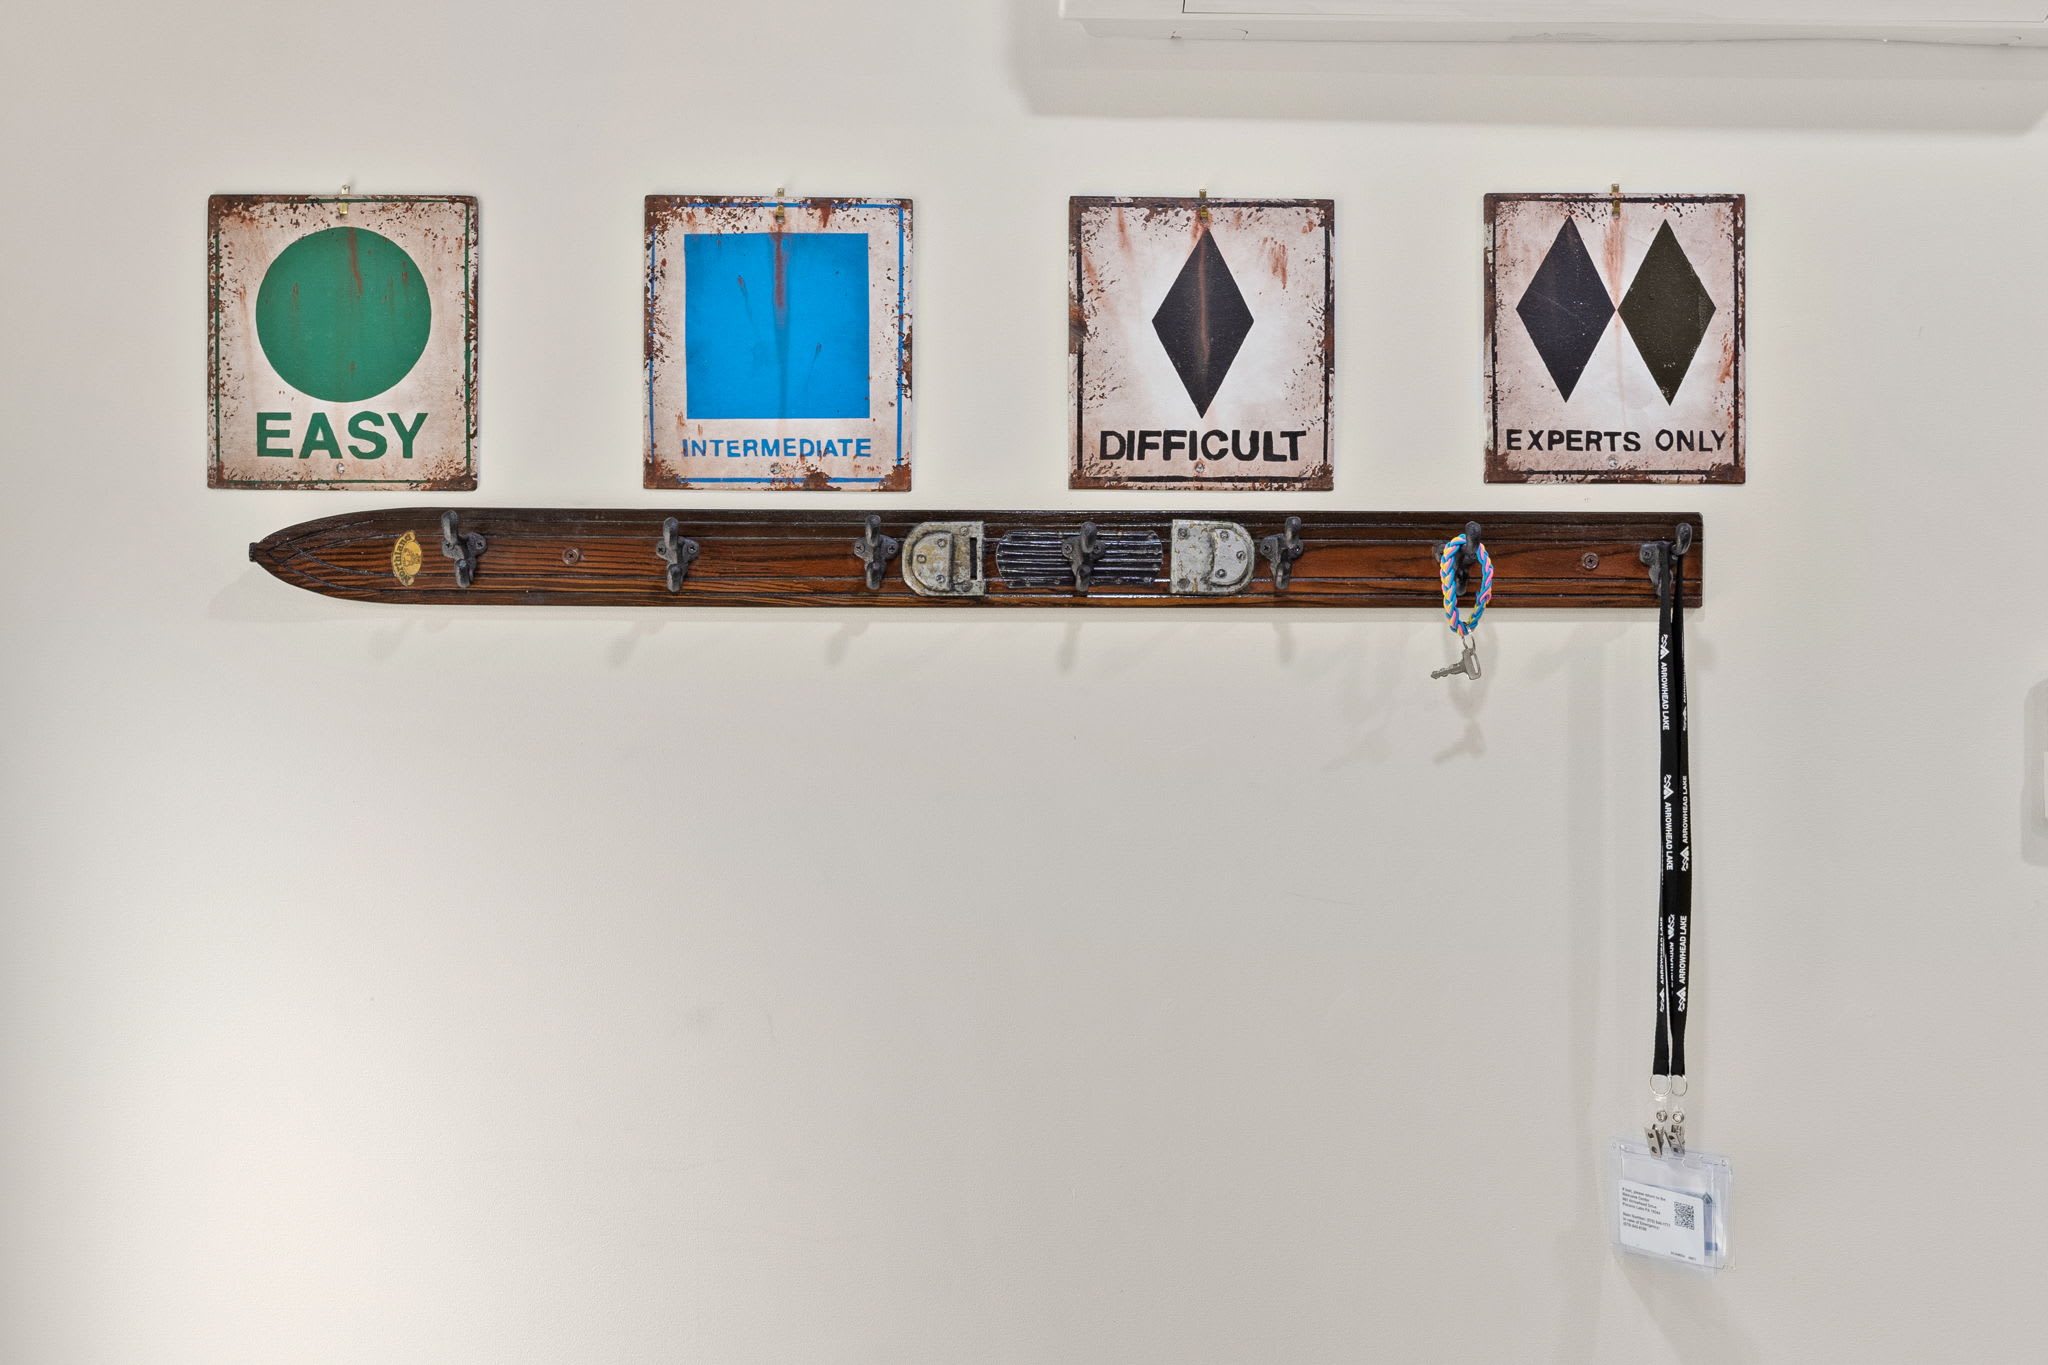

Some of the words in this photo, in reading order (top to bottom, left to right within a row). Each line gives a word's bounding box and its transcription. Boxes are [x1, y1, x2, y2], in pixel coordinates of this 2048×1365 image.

[256, 411, 428, 459] EASY
[682, 438, 871, 457] INTERMEDIATE
[1100, 429, 1306, 461] DIFFICULT
[1506, 428, 1641, 451] EXPERTS
[1655, 428, 1727, 451] ONLY
[1661, 661, 1669, 710] ARROWHEAD
[1662, 710, 1670, 731] LAKE
[1664, 801, 1673, 850] ARROWHEAD
[1665, 850, 1674, 871] LAKE
[1679, 936, 1687, 984] ARROWHEAD
